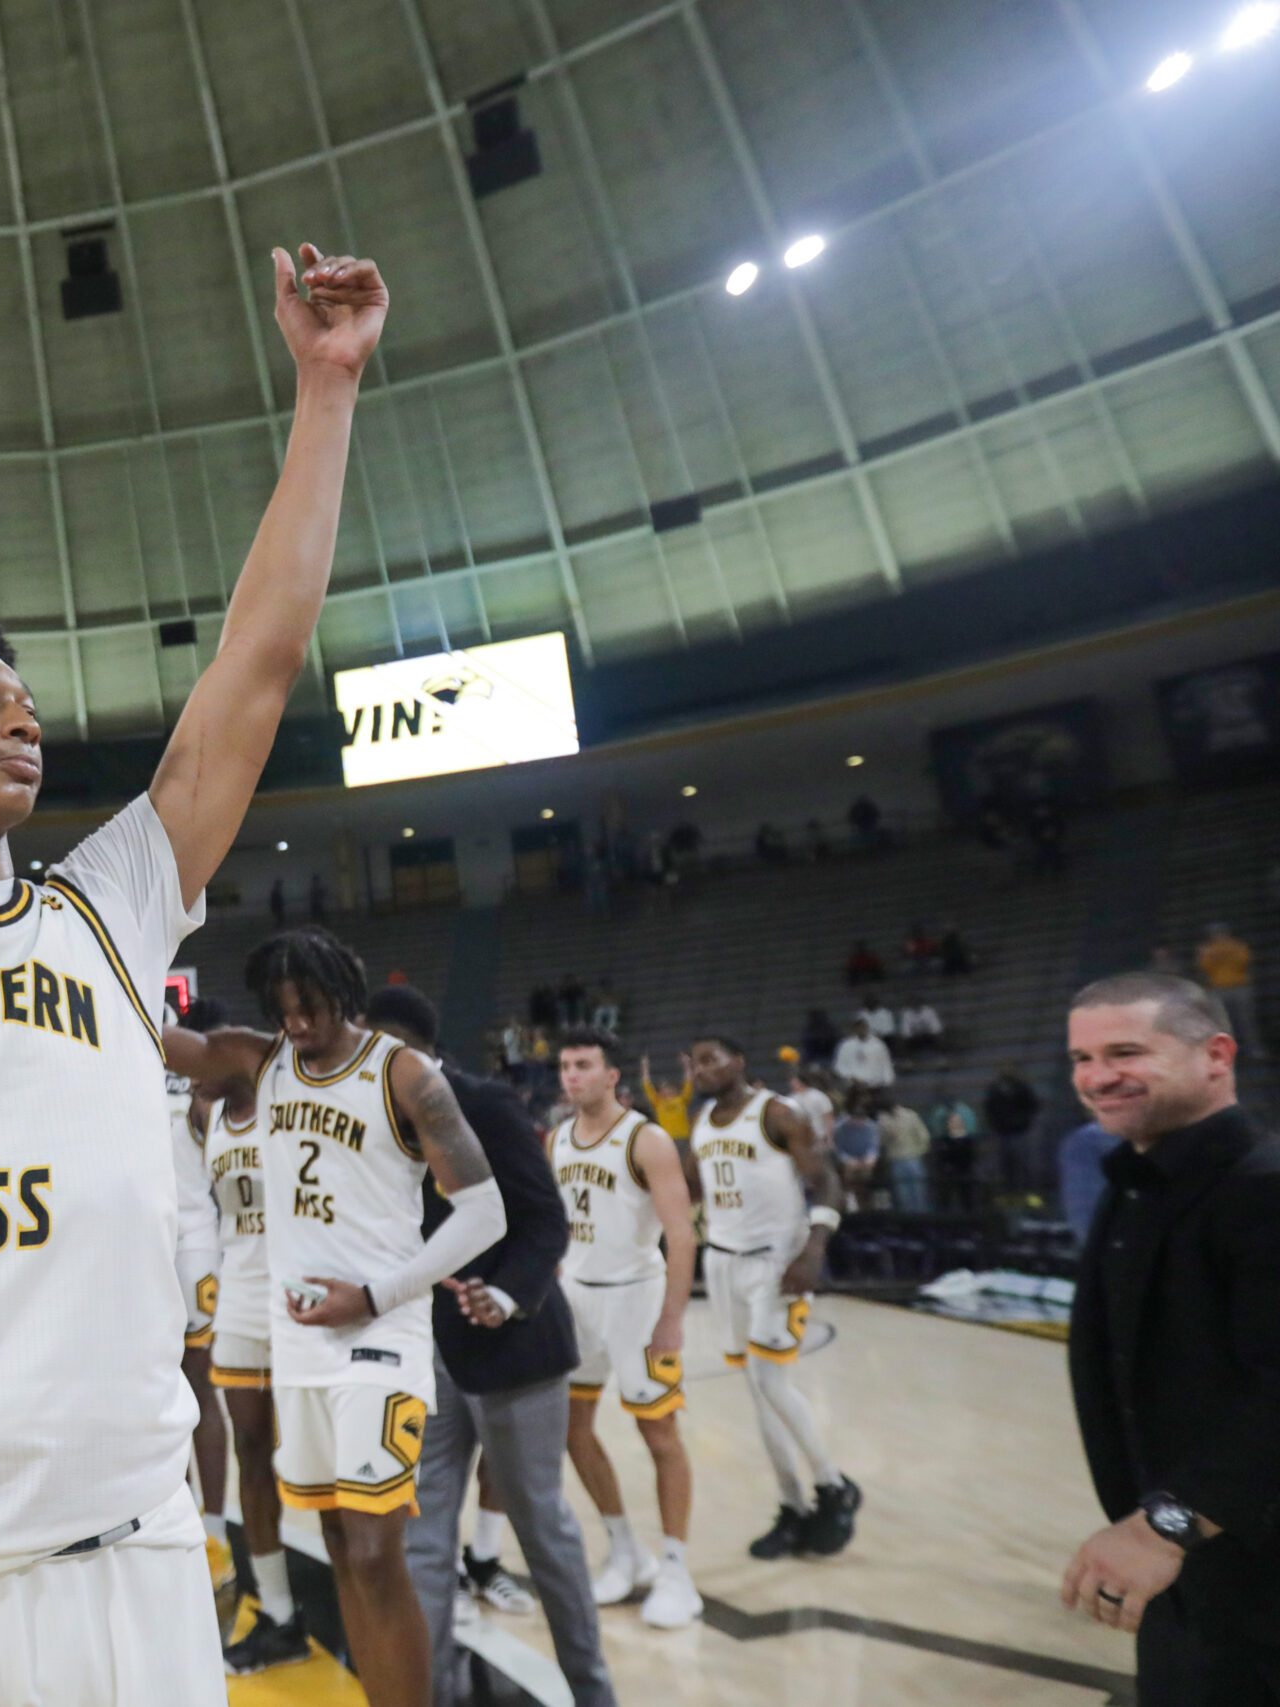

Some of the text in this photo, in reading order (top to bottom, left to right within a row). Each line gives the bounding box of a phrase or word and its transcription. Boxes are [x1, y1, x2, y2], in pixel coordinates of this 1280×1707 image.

[210, 1146, 263, 1184] SOUTHE
[298, 1140, 321, 1185] 2
[559, 1163, 617, 1193] OUTHERN
[712, 1160, 736, 1187] 10
[236, 1174, 253, 1208] 0
[292, 1186, 335, 1226] MSS
